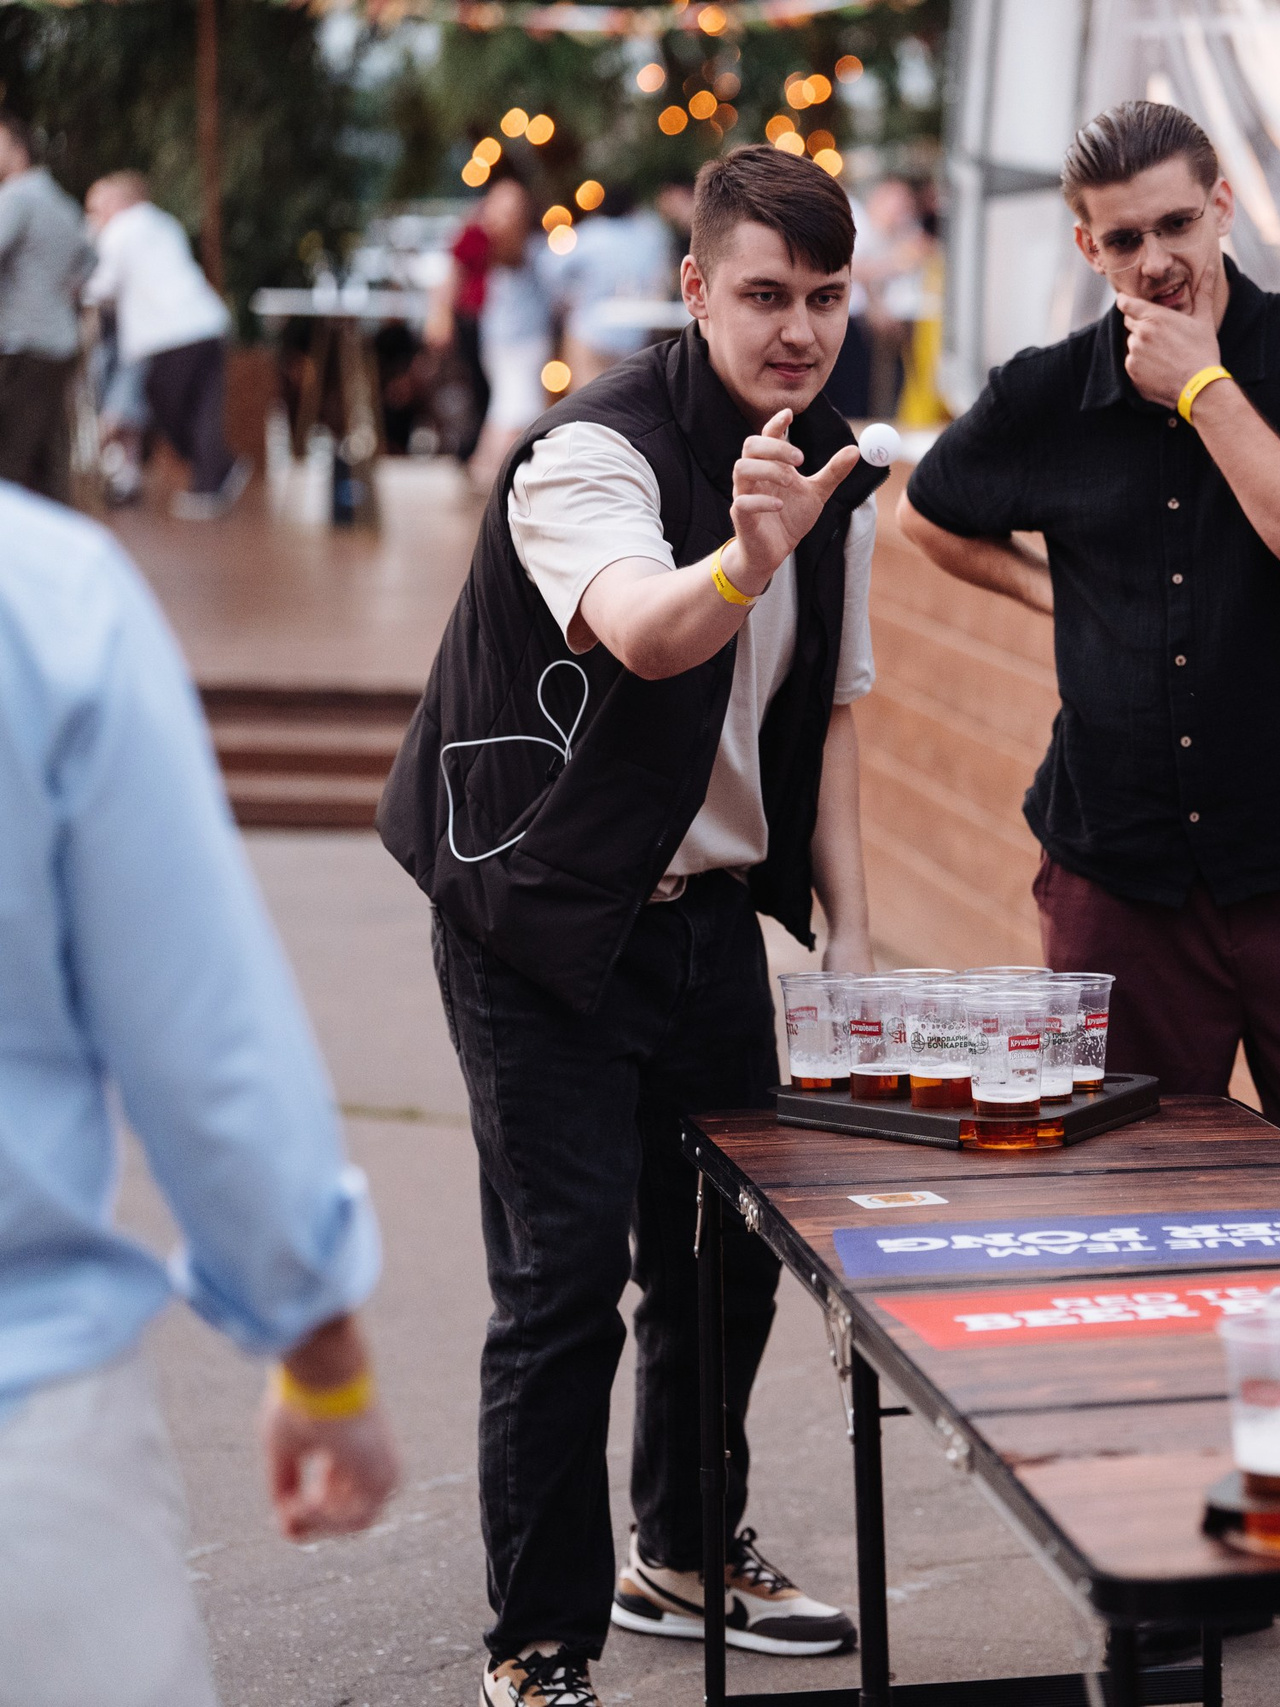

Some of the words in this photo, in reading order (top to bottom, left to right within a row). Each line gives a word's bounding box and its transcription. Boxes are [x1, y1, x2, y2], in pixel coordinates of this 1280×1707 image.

[876, 1227, 1148, 1253] PONG
[986, 1241, 1156, 1258] TEAM
[1051, 1291, 1178, 1310] RED
[954, 1302, 1199, 1332] BEER
